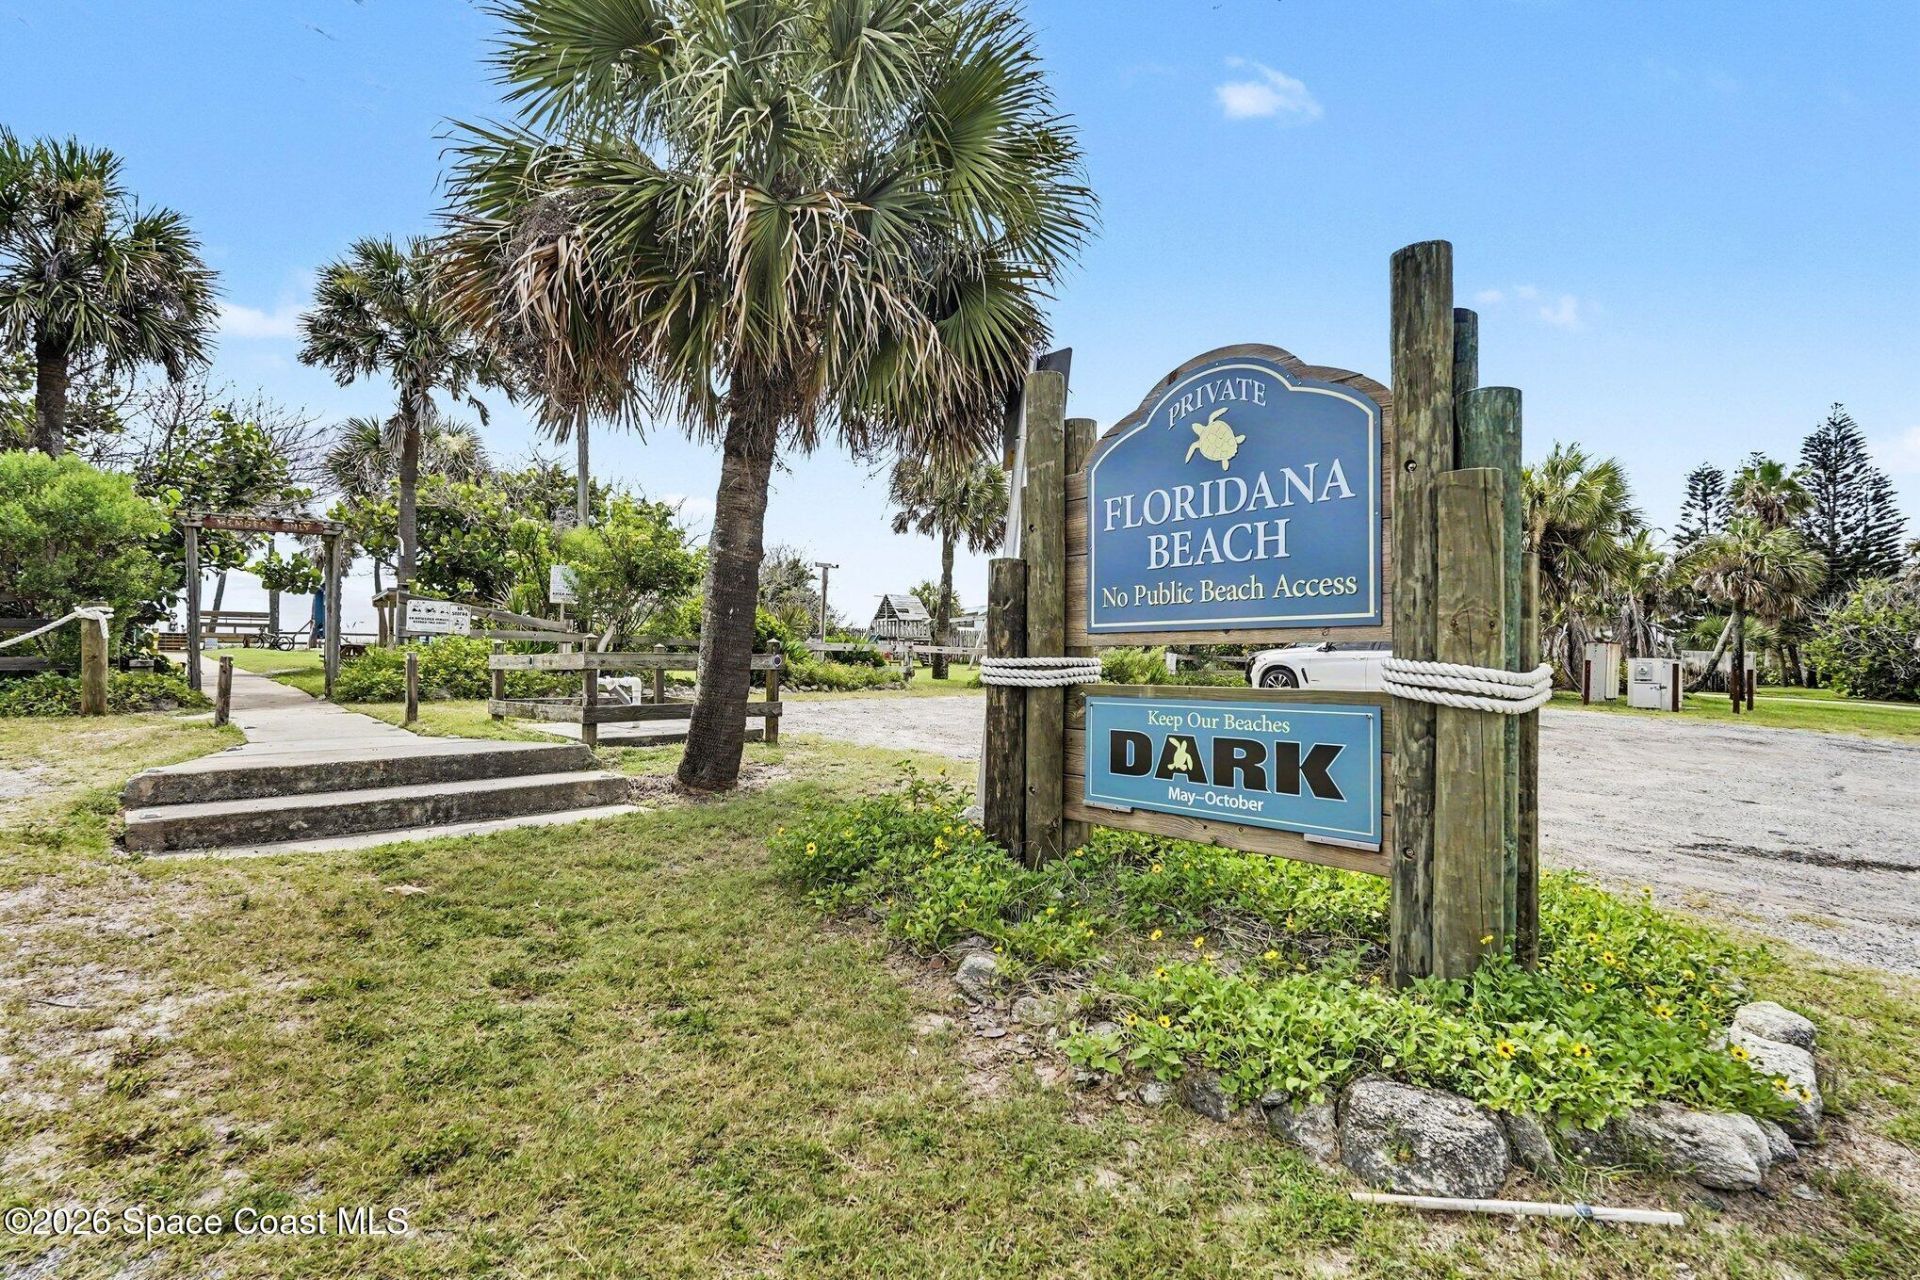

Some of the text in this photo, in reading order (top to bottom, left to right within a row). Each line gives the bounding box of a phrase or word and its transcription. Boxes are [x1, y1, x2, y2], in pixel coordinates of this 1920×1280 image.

[1168, 378, 1267, 430] PRIVATE
[1103, 458, 1357, 532] FLORIDANA
[1147, 518, 1291, 570] BEACH
[1101, 574, 1358, 608] No Public Beach Access
[1148, 710, 1291, 734] Keep Our Beaches
[1109, 728, 1347, 802] DARK
